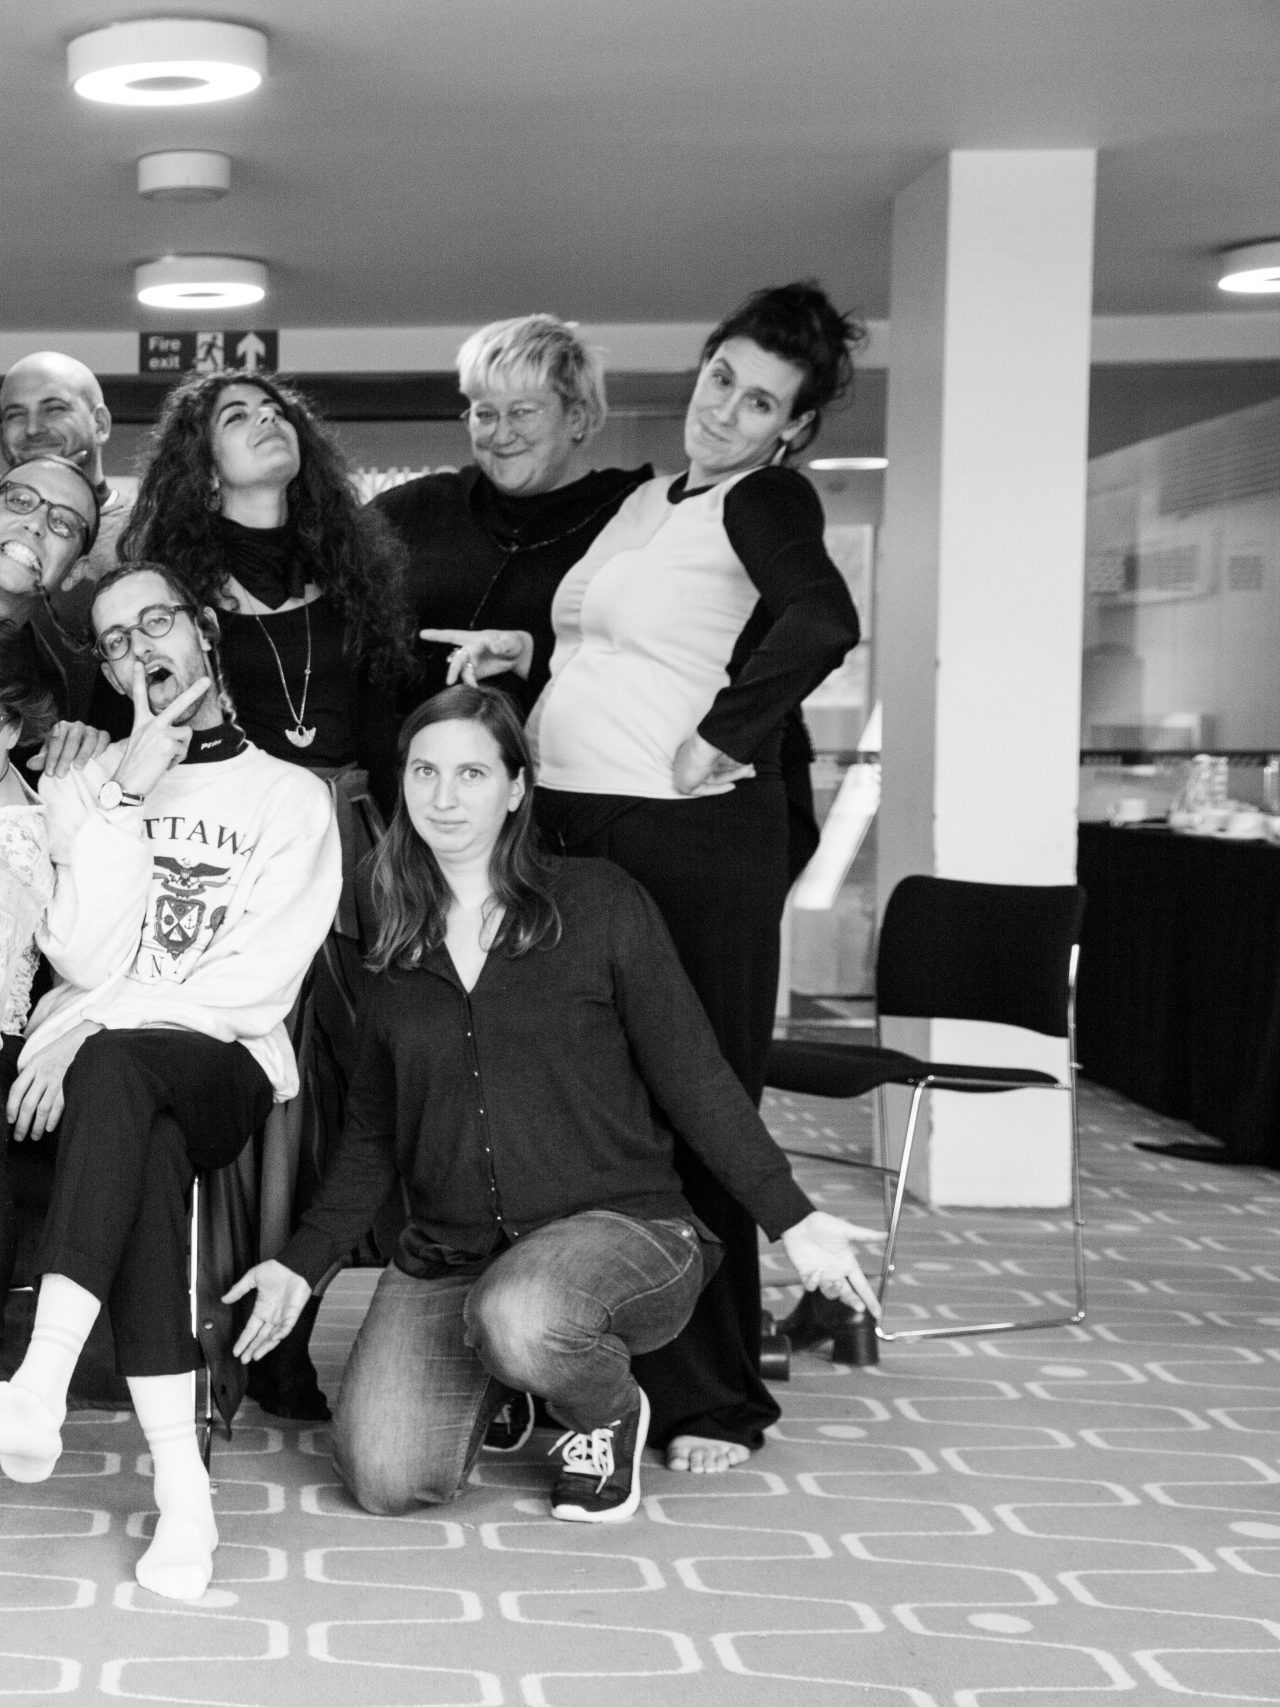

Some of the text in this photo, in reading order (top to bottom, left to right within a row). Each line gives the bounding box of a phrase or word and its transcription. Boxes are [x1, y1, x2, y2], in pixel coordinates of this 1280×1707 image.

[148, 336, 182, 352] Fire
[148, 354, 181, 370] exit
[142, 816, 257, 857] TTAWA
